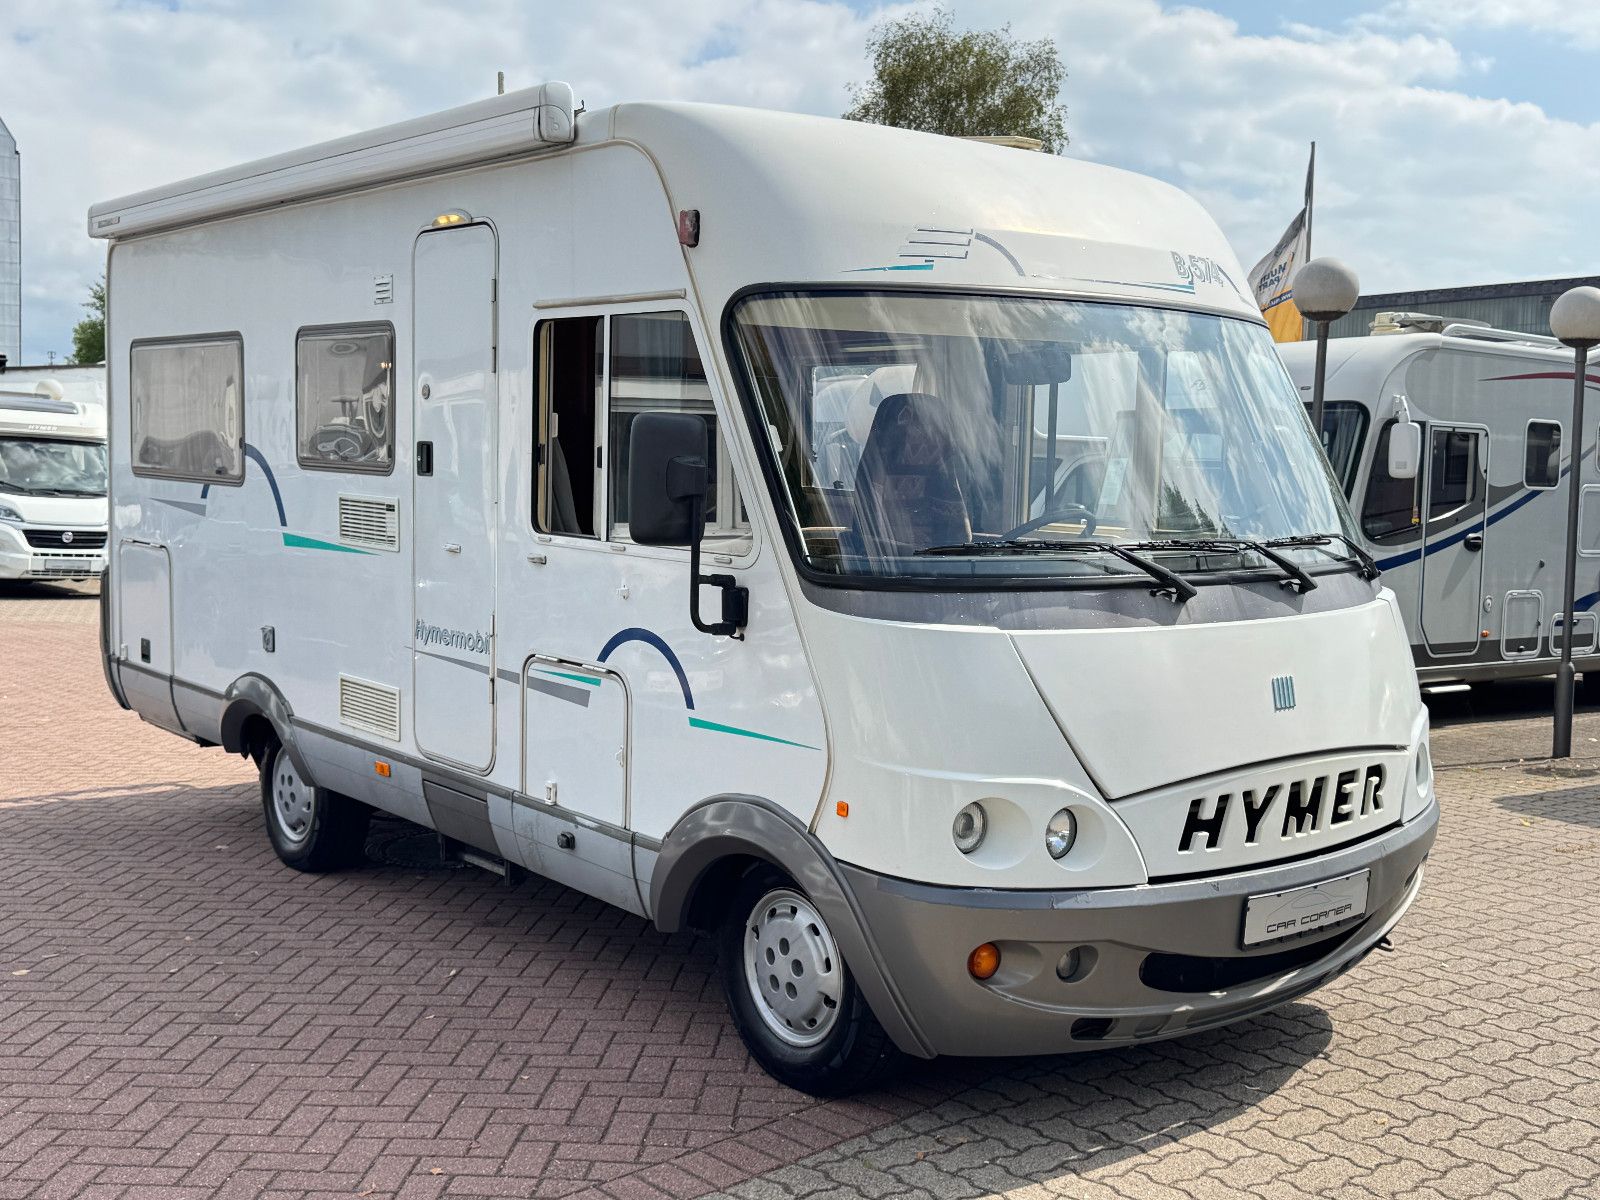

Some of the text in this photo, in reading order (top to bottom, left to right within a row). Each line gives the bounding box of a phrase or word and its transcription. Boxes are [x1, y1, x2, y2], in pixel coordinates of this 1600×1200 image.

[1177, 763, 1387, 854] HYMER
[1266, 903, 1352, 933] CAR CORNER
